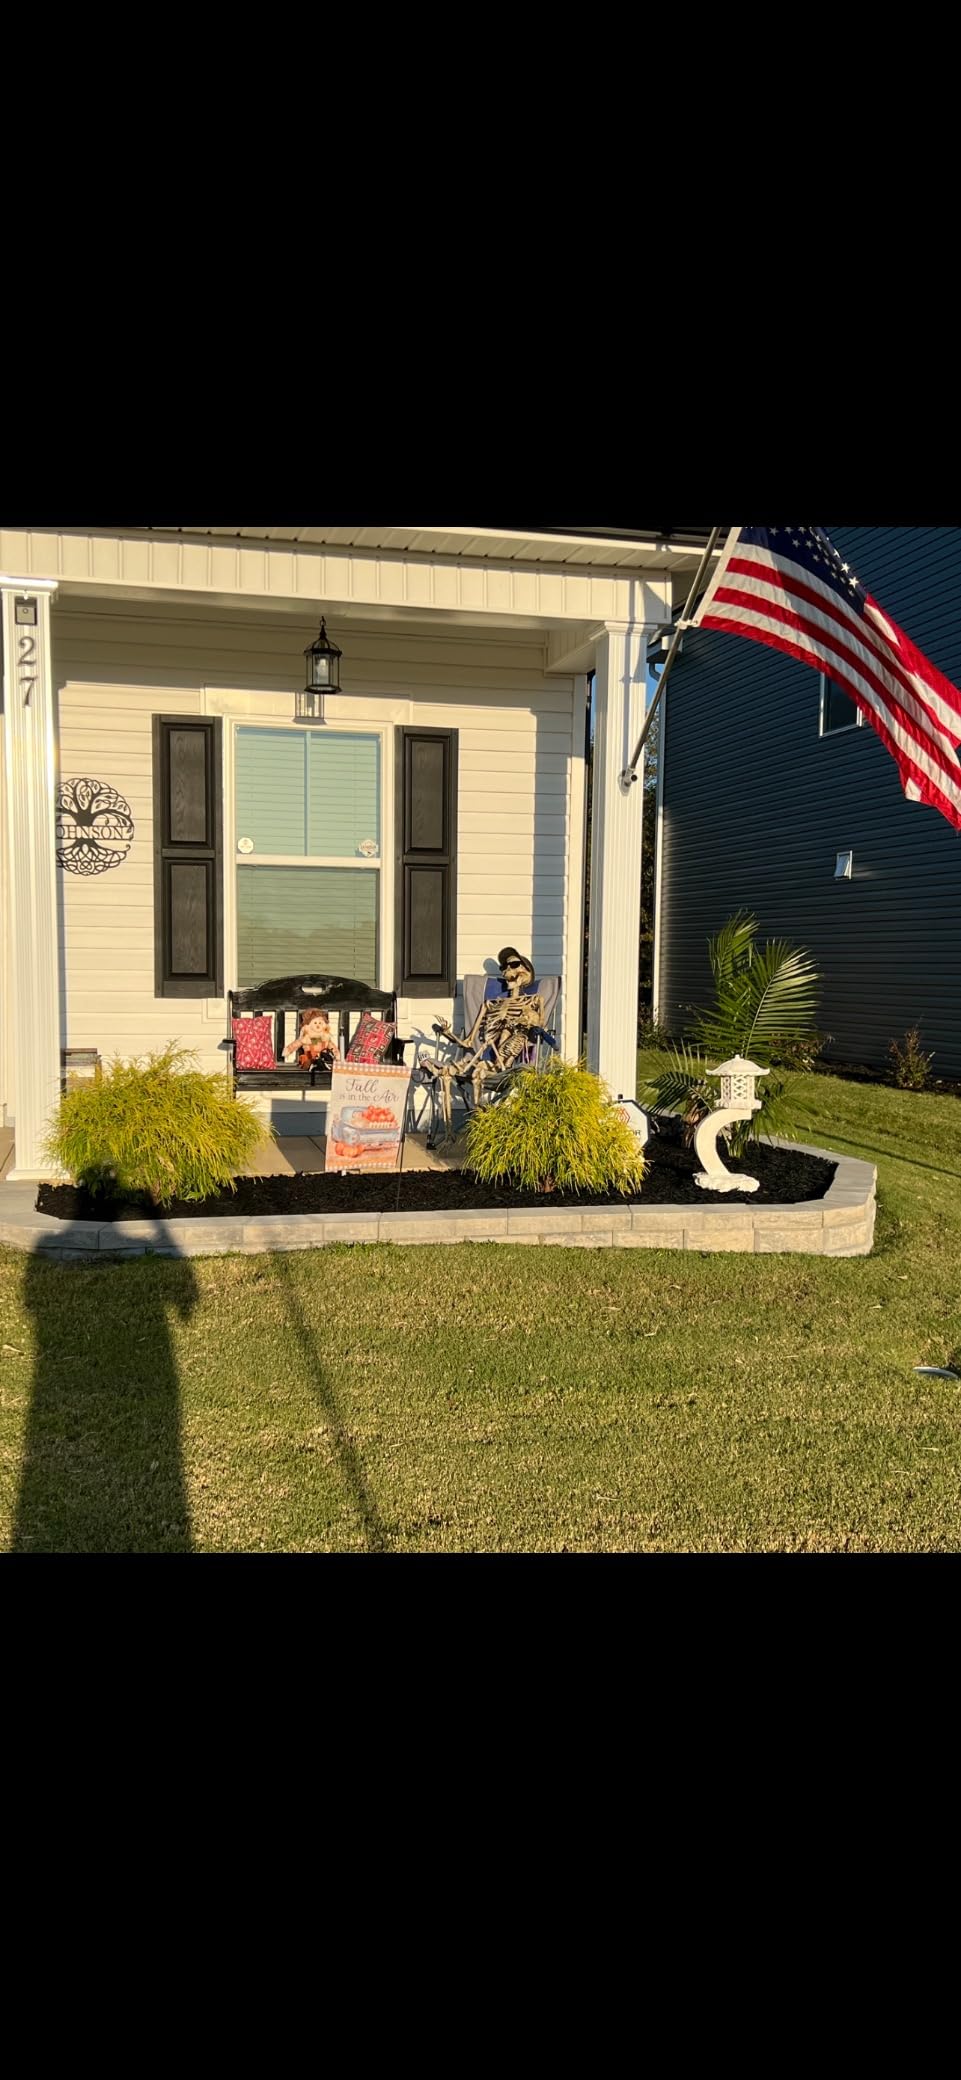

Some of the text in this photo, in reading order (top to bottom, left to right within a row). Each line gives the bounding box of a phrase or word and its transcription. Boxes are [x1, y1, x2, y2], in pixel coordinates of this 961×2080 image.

[16, 635, 38, 708] 27
[55, 825, 124, 841] OHNSON
[345, 1079, 378, 1094] Fall
[348, 1093, 356, 1101] in
[358, 1092, 371, 1102] the
[373, 1089, 399, 1104] Air
